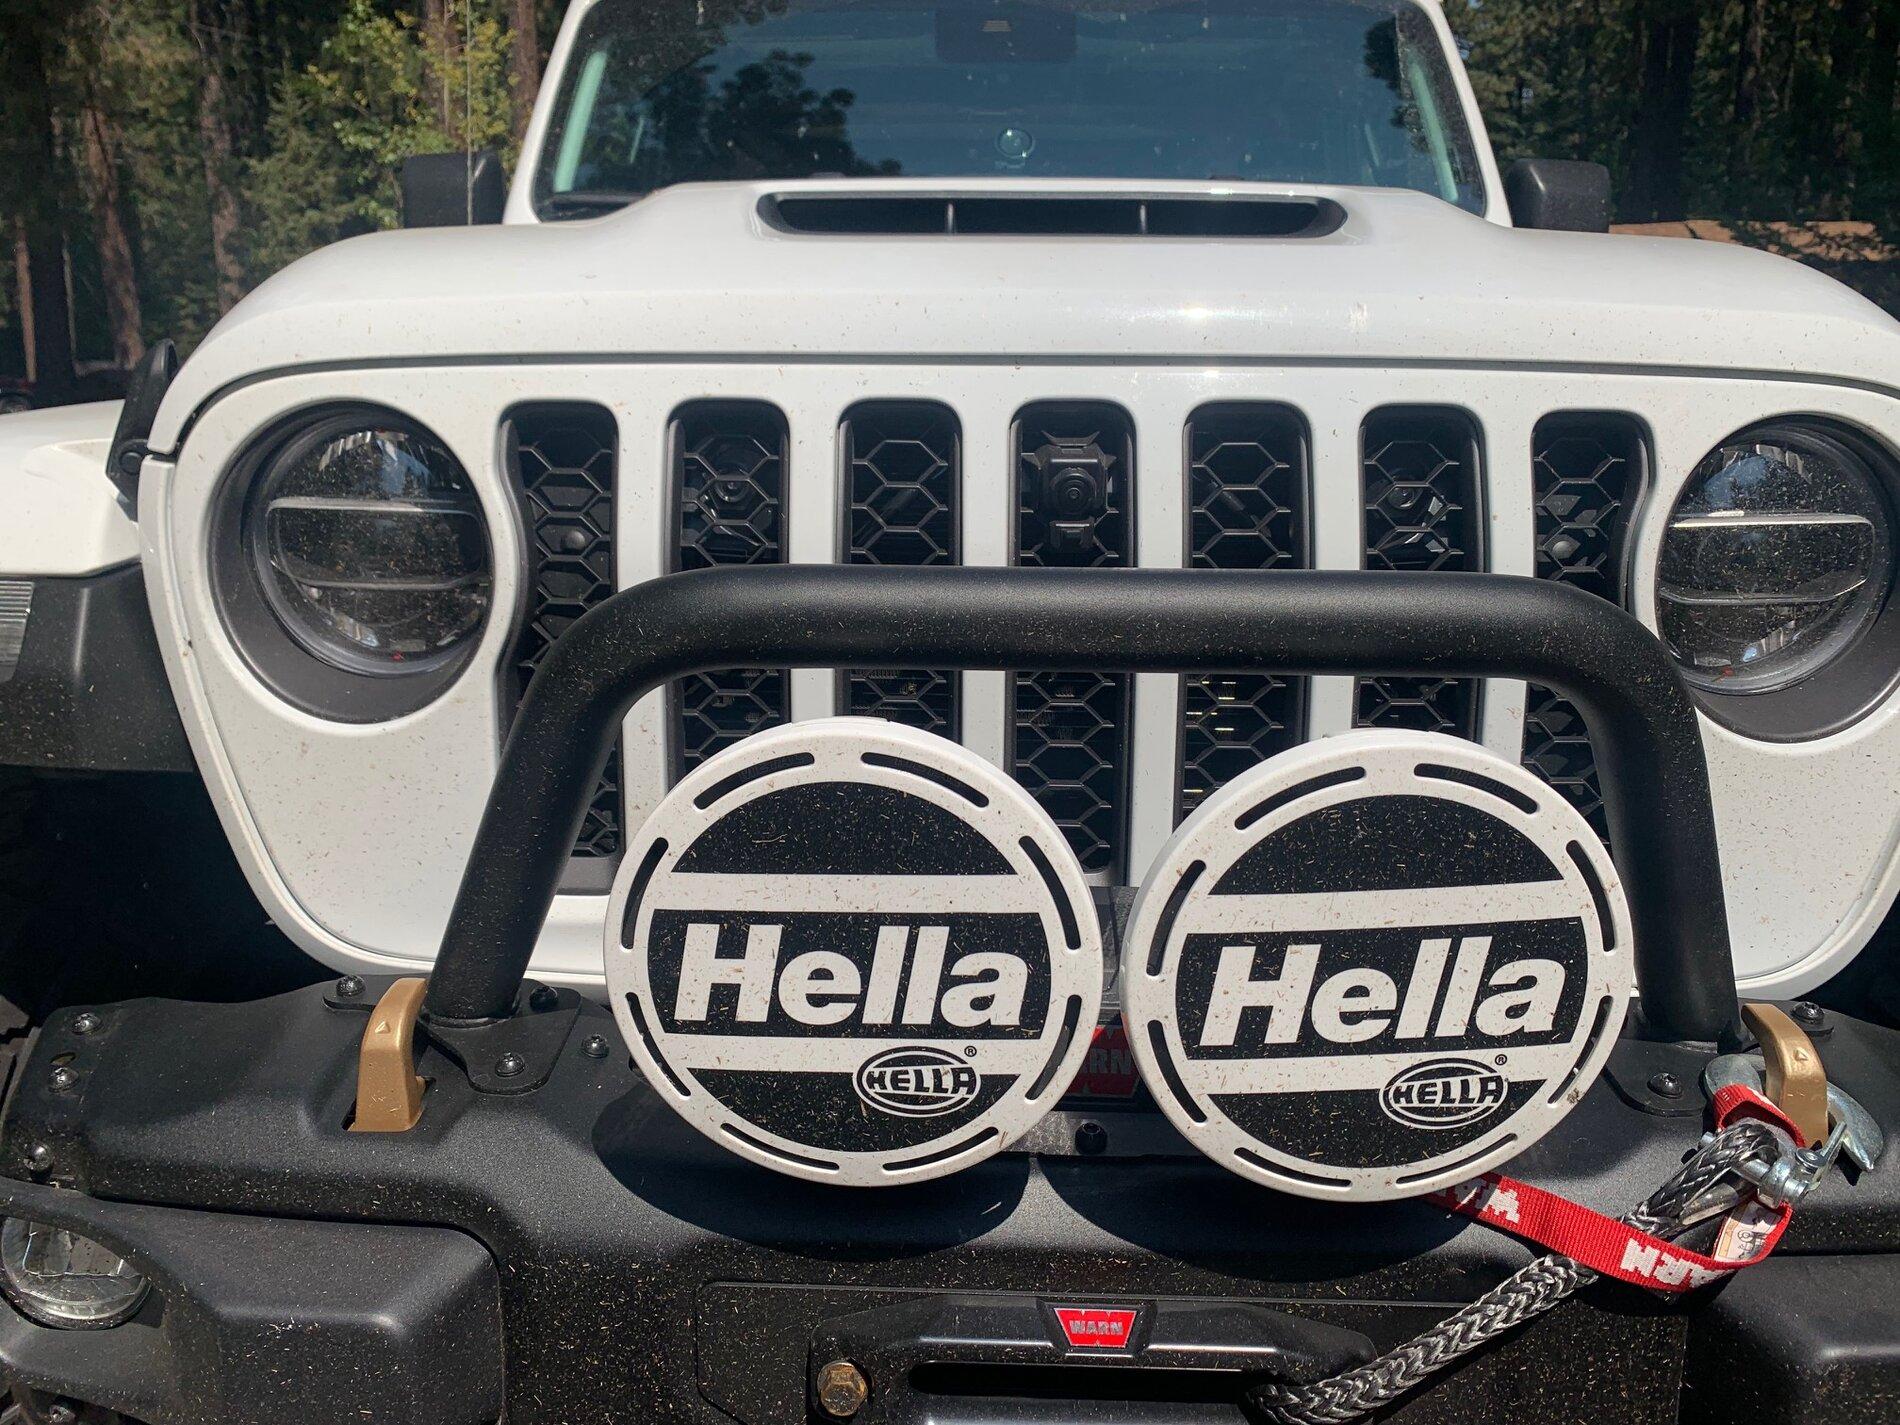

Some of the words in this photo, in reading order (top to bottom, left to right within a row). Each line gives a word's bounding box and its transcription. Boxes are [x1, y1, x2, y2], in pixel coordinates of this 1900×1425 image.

[673, 922, 1030, 1028] Hella
[1199, 935, 1566, 1046] Hella
[1082, 1047, 1133, 1074] RN
[865, 1067, 974, 1096] HELLA
[1394, 1073, 1500, 1105] HELLA
[1068, 1320, 1124, 1335] WARN
